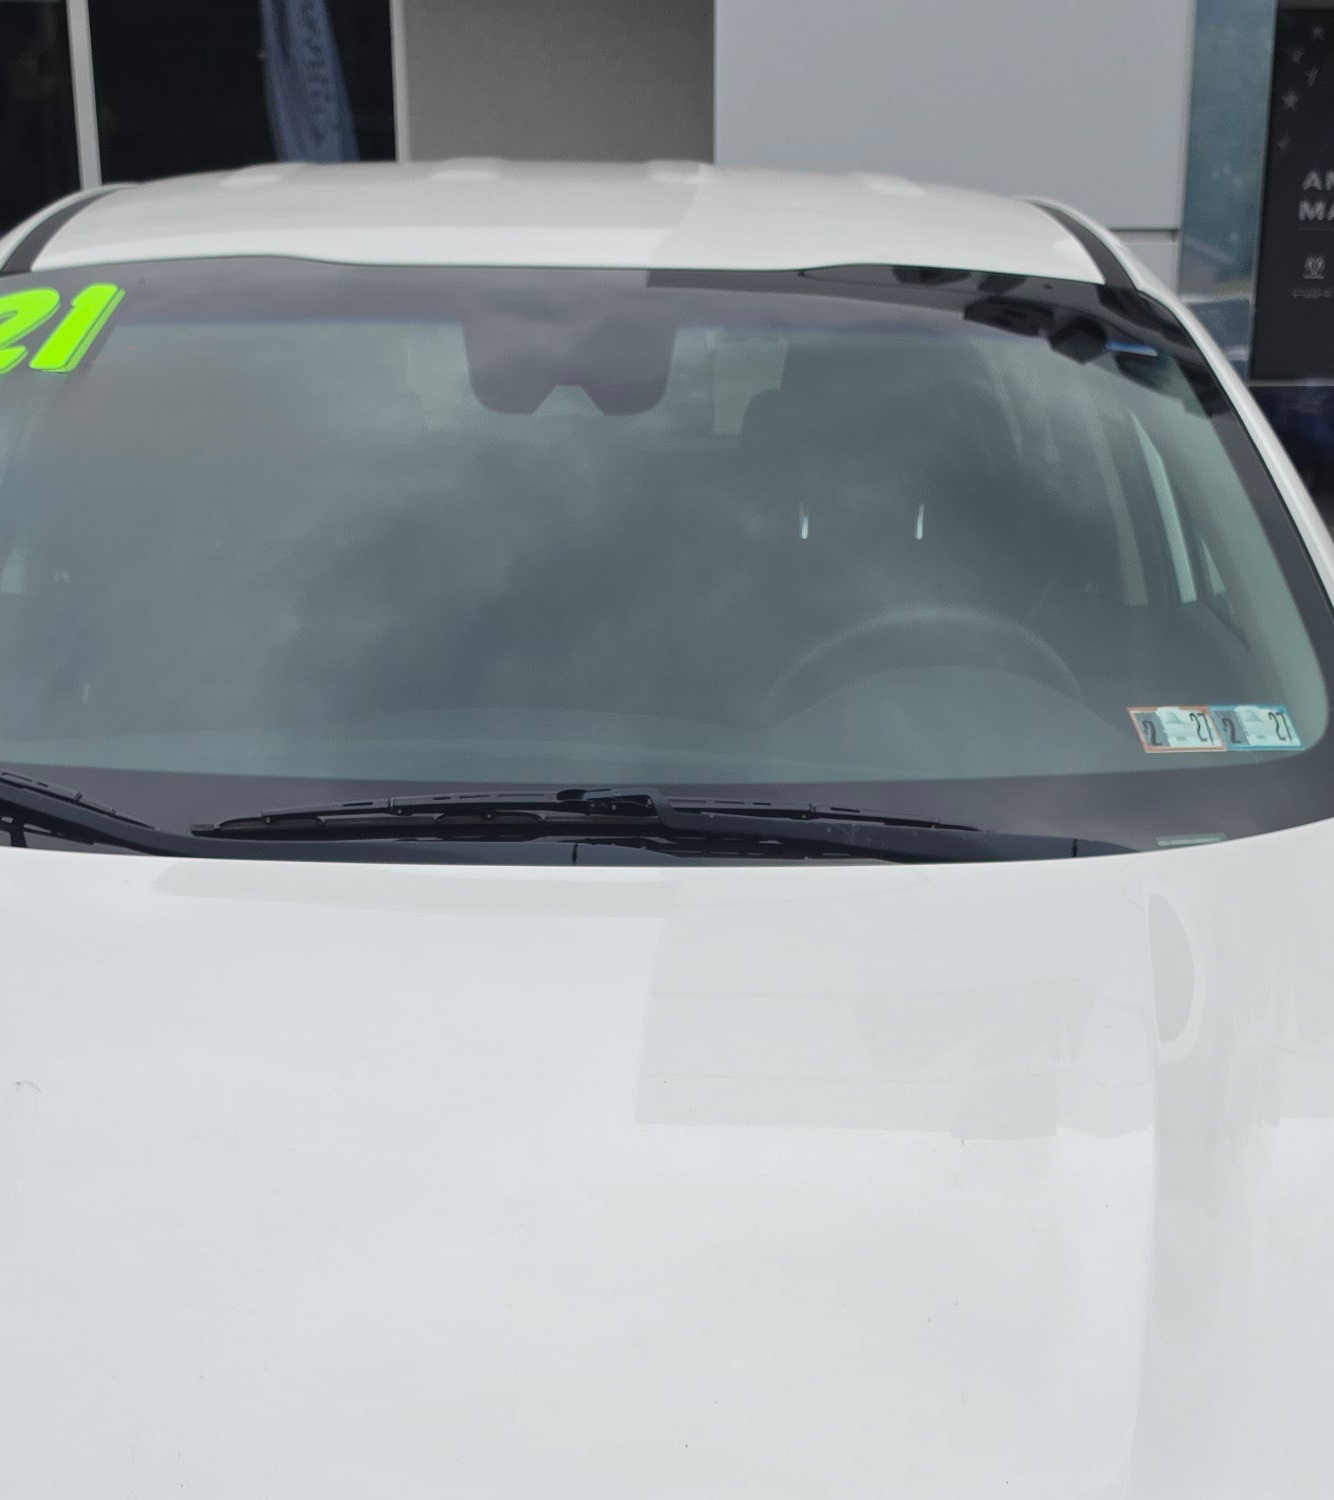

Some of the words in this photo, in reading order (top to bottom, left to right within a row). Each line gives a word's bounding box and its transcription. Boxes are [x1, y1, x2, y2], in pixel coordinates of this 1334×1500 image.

[1142, 719, 1163, 746] 2
[1189, 712, 1214, 745] 27
[1222, 718, 1242, 743] 2
[1268, 711, 1292, 742] 27
